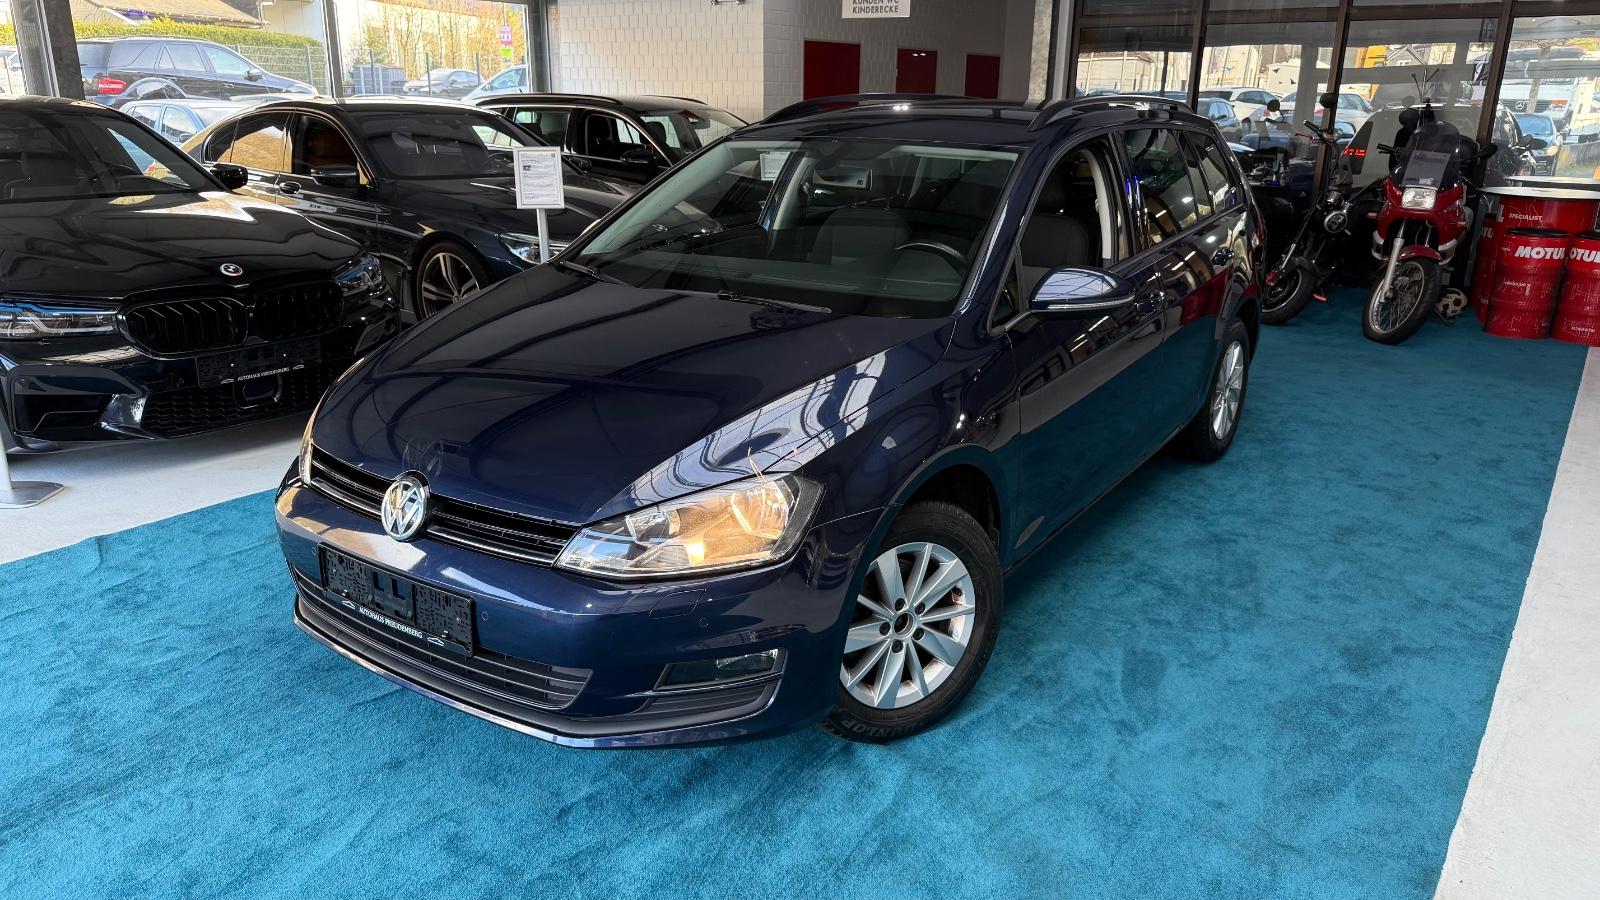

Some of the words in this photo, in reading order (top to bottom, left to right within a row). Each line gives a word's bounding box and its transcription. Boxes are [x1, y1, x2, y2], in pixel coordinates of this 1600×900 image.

[852, 6, 899, 14] KINDERECKE
[1509, 213, 1543, 221] SPECIALIST
[359, 606, 385, 623] AUTOHAUS
